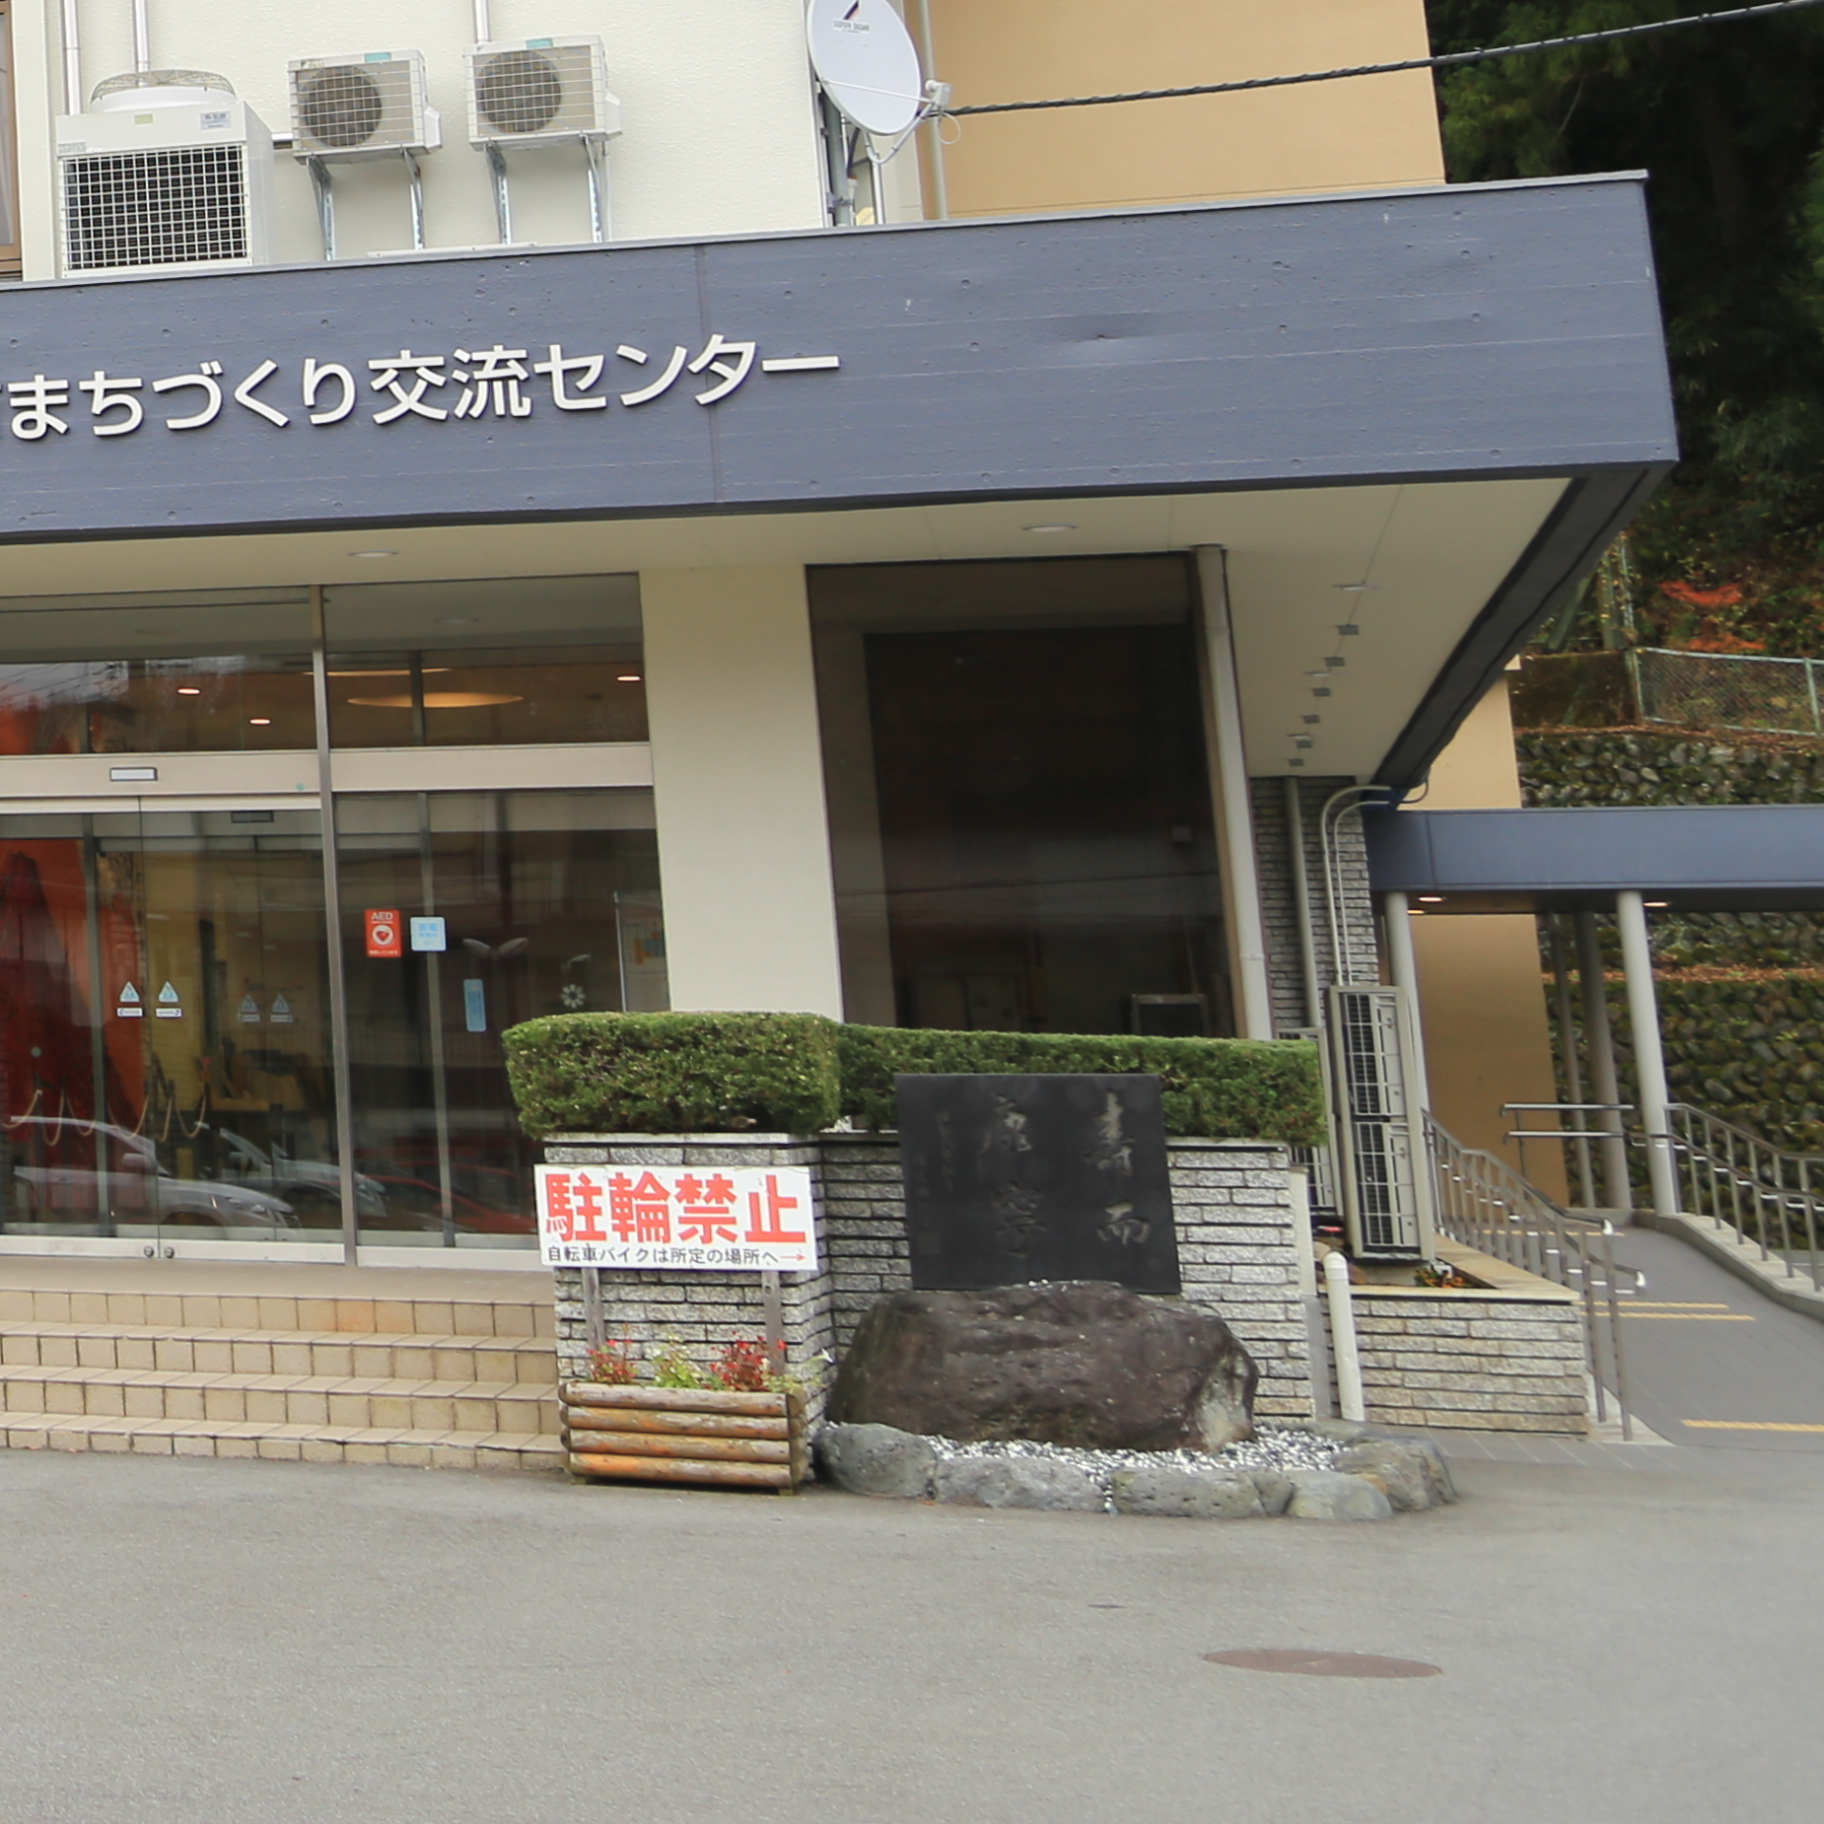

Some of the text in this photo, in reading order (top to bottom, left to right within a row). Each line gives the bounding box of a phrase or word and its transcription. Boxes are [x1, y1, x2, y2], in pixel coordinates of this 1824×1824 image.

[372, 911, 394, 922] AED
[545, 1171, 806, 1244] 駐輪禁止
[547, 1245, 779, 1266] 自転車バイクは所定の場所へ
